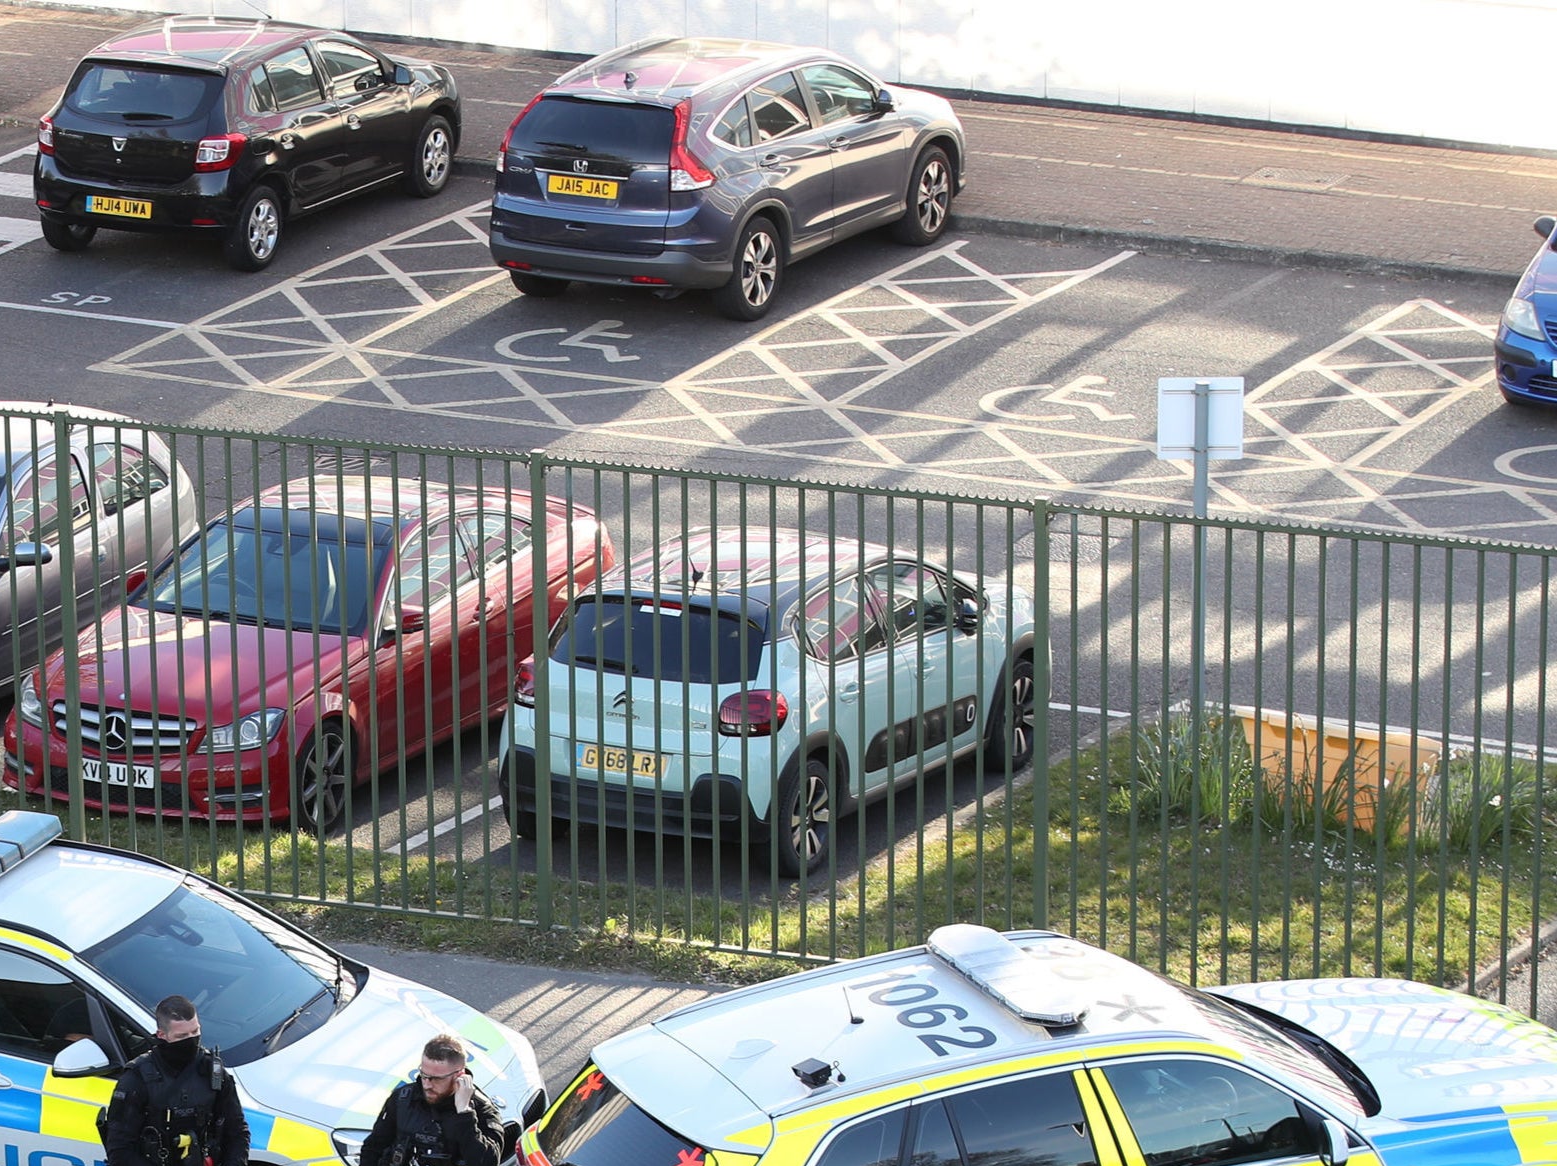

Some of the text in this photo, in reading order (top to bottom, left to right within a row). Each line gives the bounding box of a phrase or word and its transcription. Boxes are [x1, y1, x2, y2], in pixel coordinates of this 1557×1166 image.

[557, 178, 610, 196] JA15 JAC
[96, 198, 146, 215] HJ14 UWA
[40, 291, 113, 307] SP
[585, 748, 625, 769] G68
[847, 972, 997, 1057] 1062
